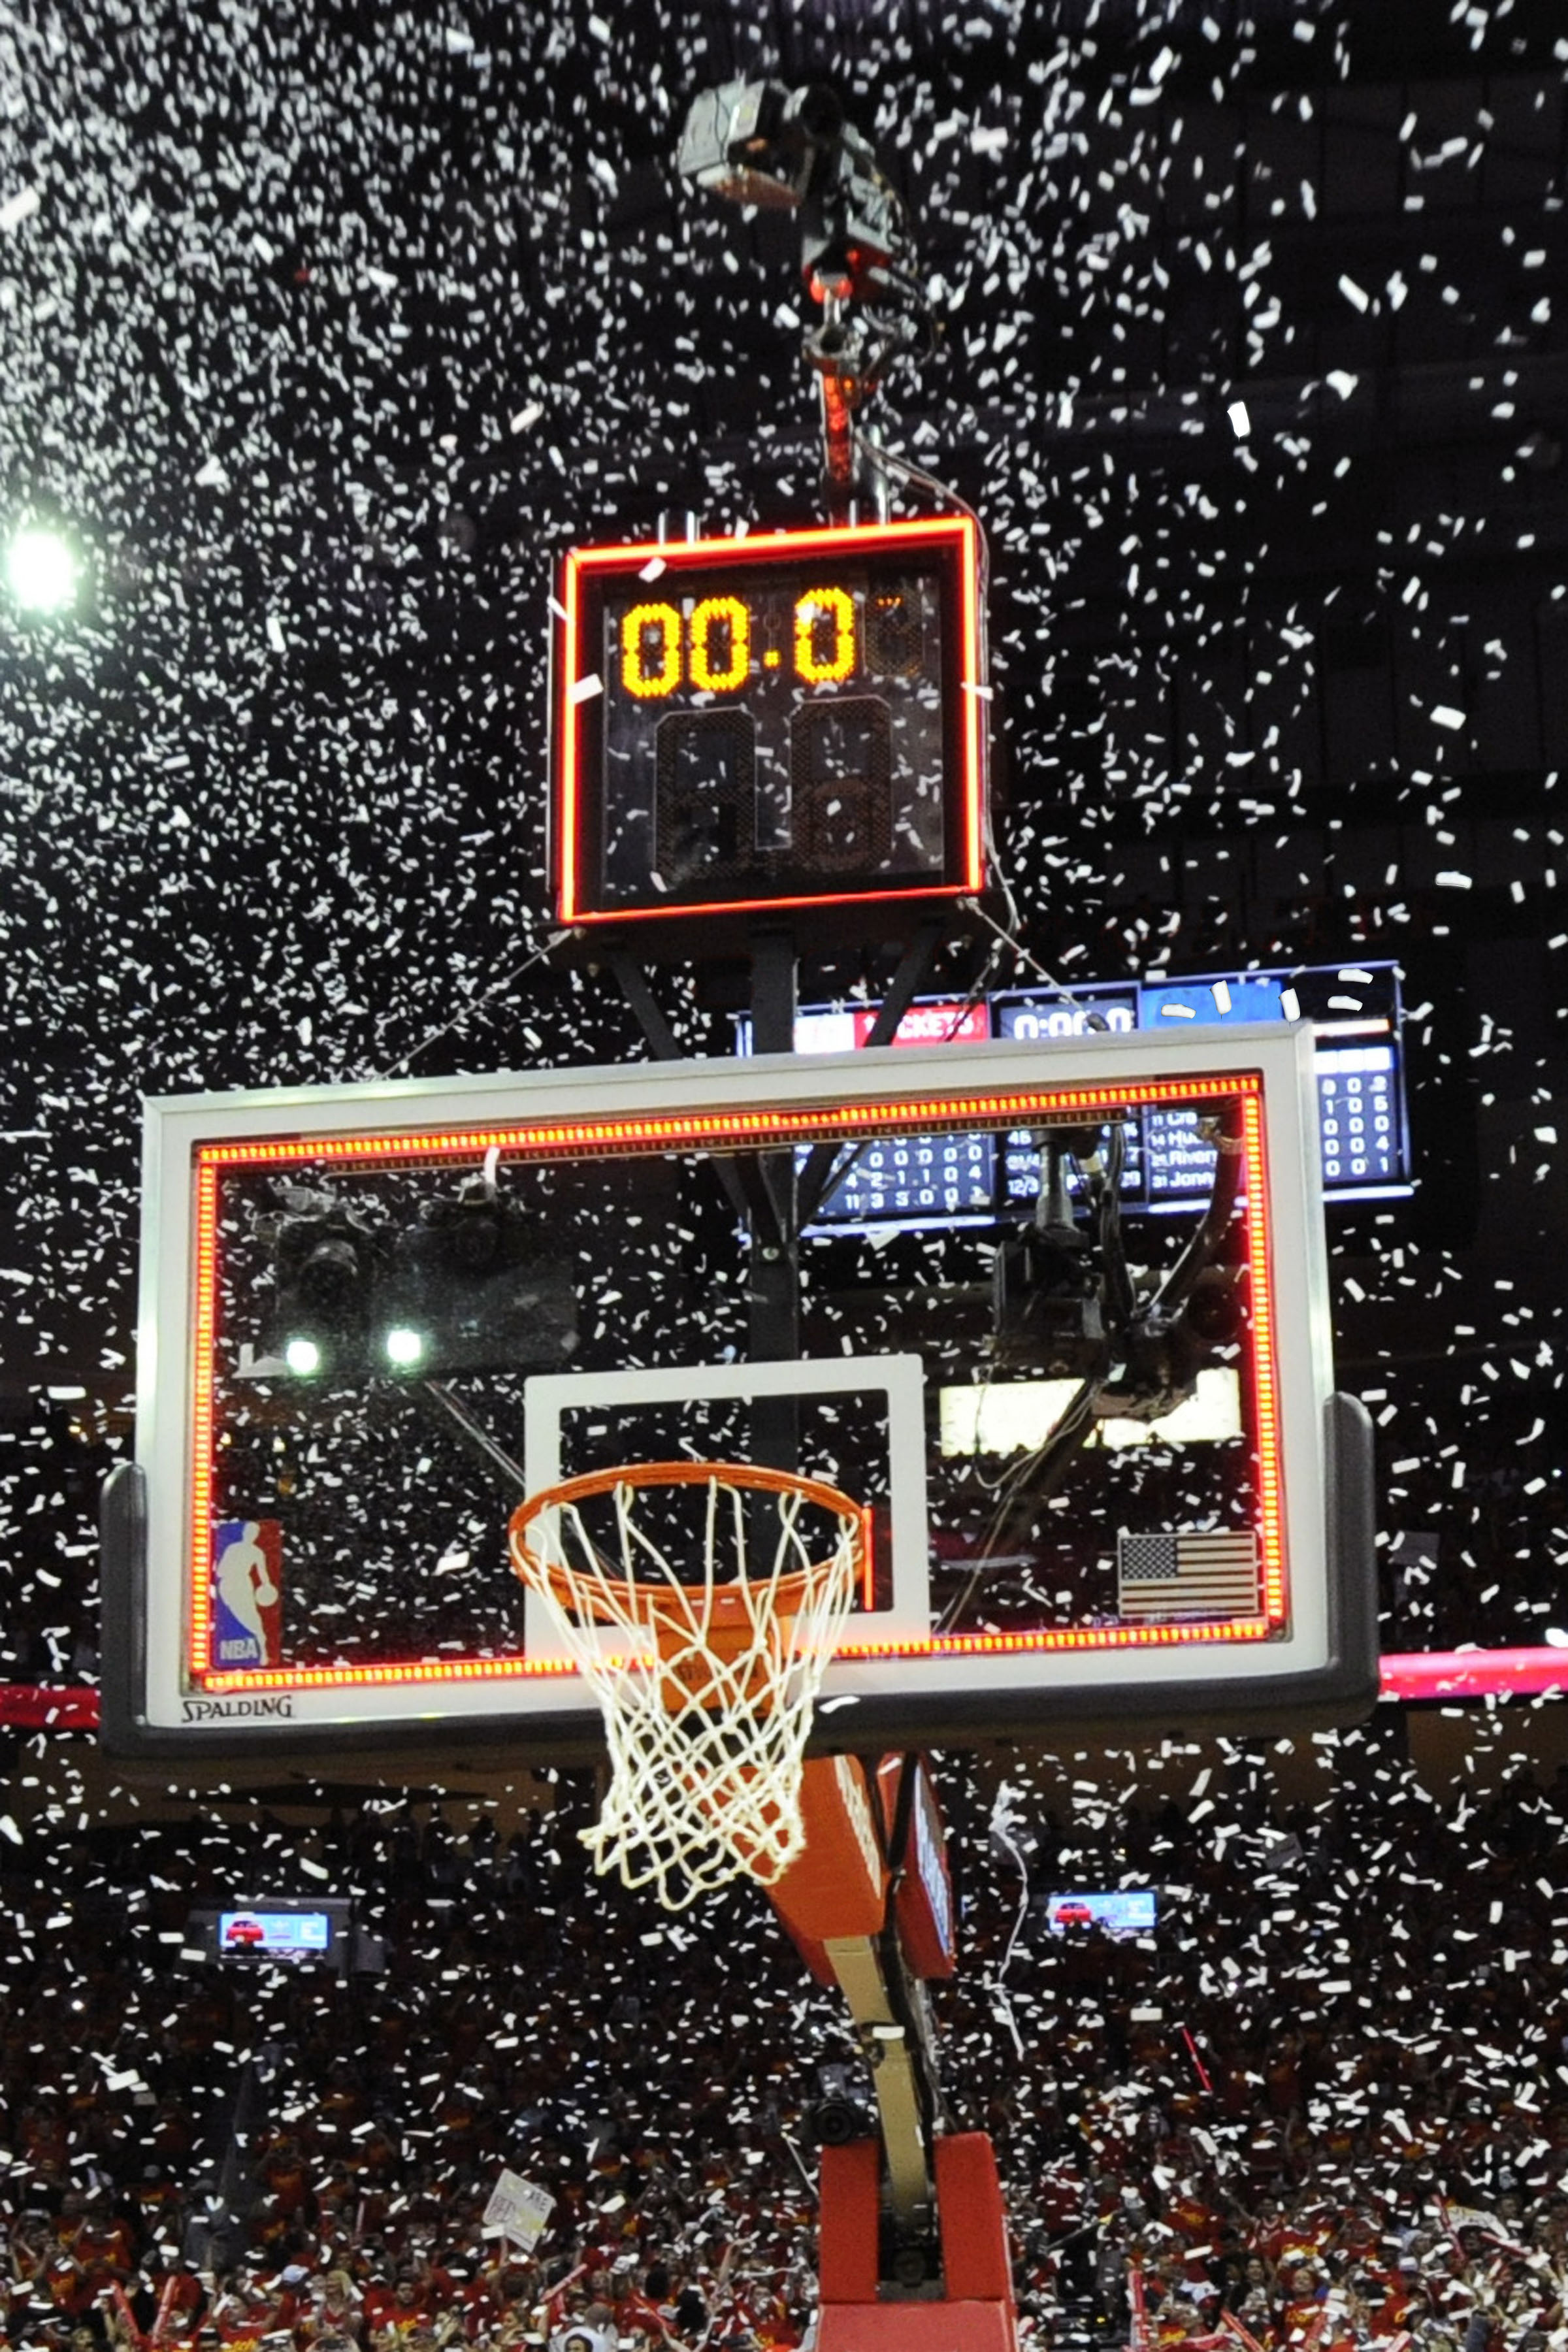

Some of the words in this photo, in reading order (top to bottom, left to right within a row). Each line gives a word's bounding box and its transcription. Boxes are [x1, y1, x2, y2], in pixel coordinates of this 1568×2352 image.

[621, 586, 855, 698] 00.0
[1347, 1077, 1362, 1094] 0
[1325, 1100, 1333, 1115] 1
[1348, 1097, 1362, 1113] 0
[1324, 1119, 1338, 1135] 0
[1349, 1117, 1364, 1134] 0
[1375, 1115, 1389, 1132] 0
[1324, 1139, 1339, 1155] 0
[1350, 1137, 1365, 1153] 0
[1376, 1135, 1389, 1151] 4
[870, 1152, 884, 1168] 0
[894, 1150, 908, 1166] 0
[919, 1149, 933, 1164] 0
[944, 1147, 958, 1162] 0
[968, 1145, 982, 1161] 0
[1326, 1160, 1340, 1176] 0
[1351, 1158, 1366, 1175] 0
[1380, 1157, 1388, 1172] 1
[845, 1173, 858, 1188] 4
[896, 1170, 906, 1184] 1
[923, 1168, 930, 1183] 1
[944, 1167, 958, 1183] 0
[969, 1165, 981, 1179] 4
[845, 1194, 860, 1209] 11
[870, 1192, 885, 1209] 3
[919, 1188, 934, 1205] 0
[945, 1186, 958, 1203] 0
[220, 1638, 259, 1659] NBA
[182, 1695, 292, 1722] SPALDING
